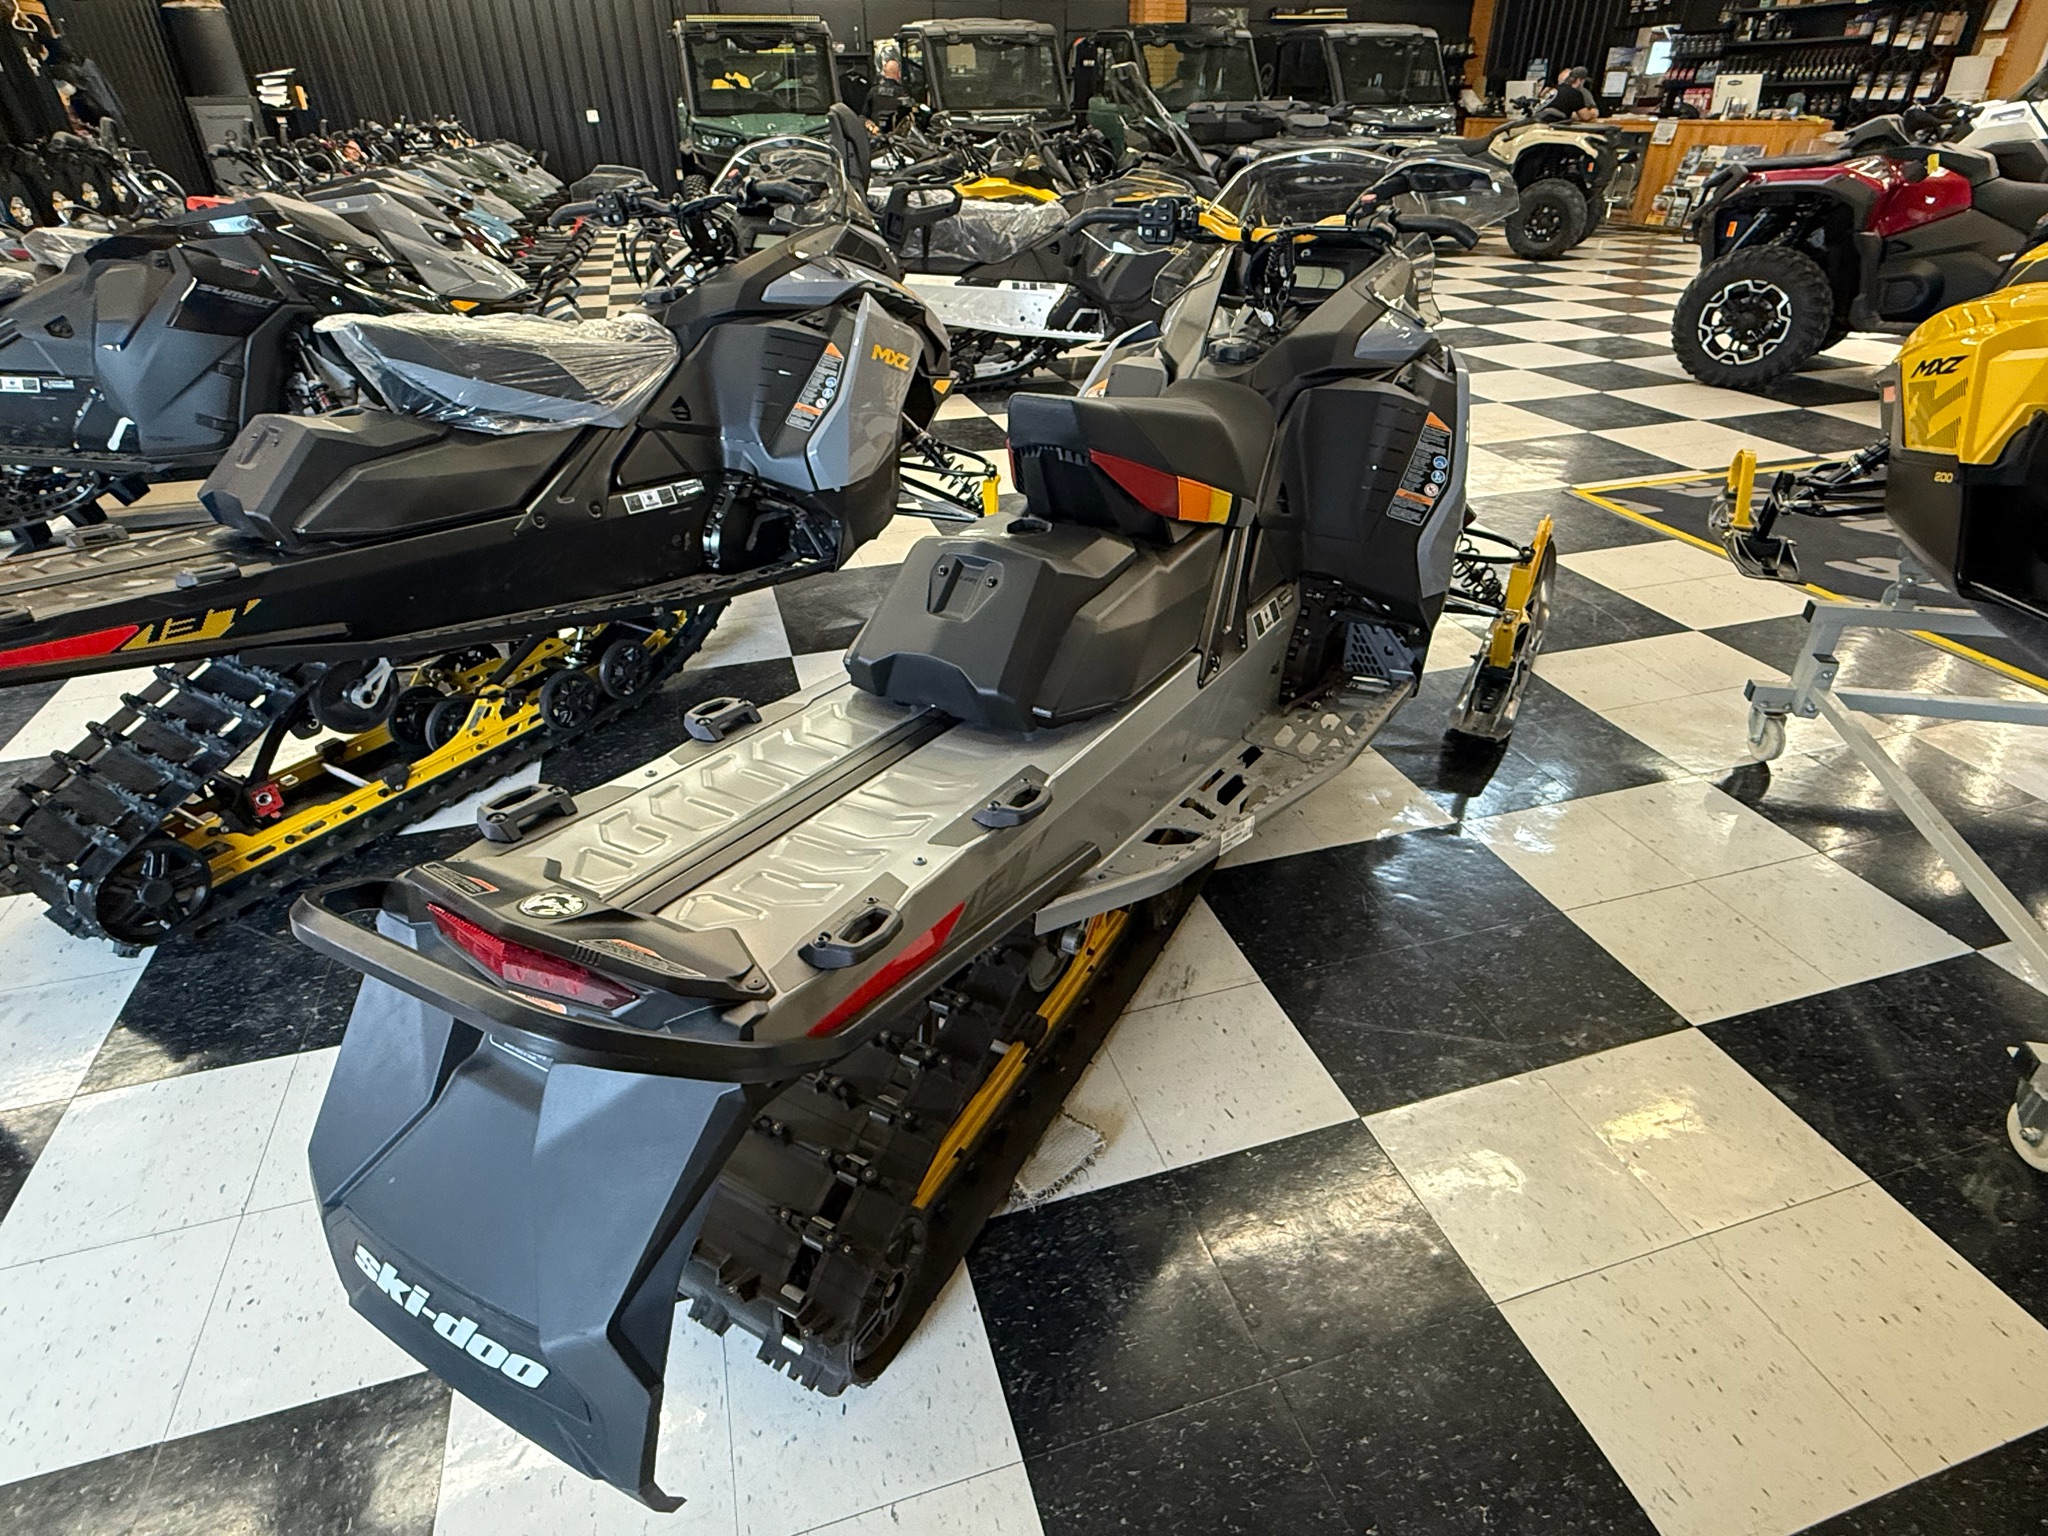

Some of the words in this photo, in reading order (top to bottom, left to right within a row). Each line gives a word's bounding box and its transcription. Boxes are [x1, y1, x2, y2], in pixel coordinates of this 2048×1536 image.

[196, 283, 280, 306] SUMMIT
[871, 344, 911, 371] MXZ
[1910, 354, 1970, 379] MXZ
[354, 1244, 550, 1389] ski-doo
